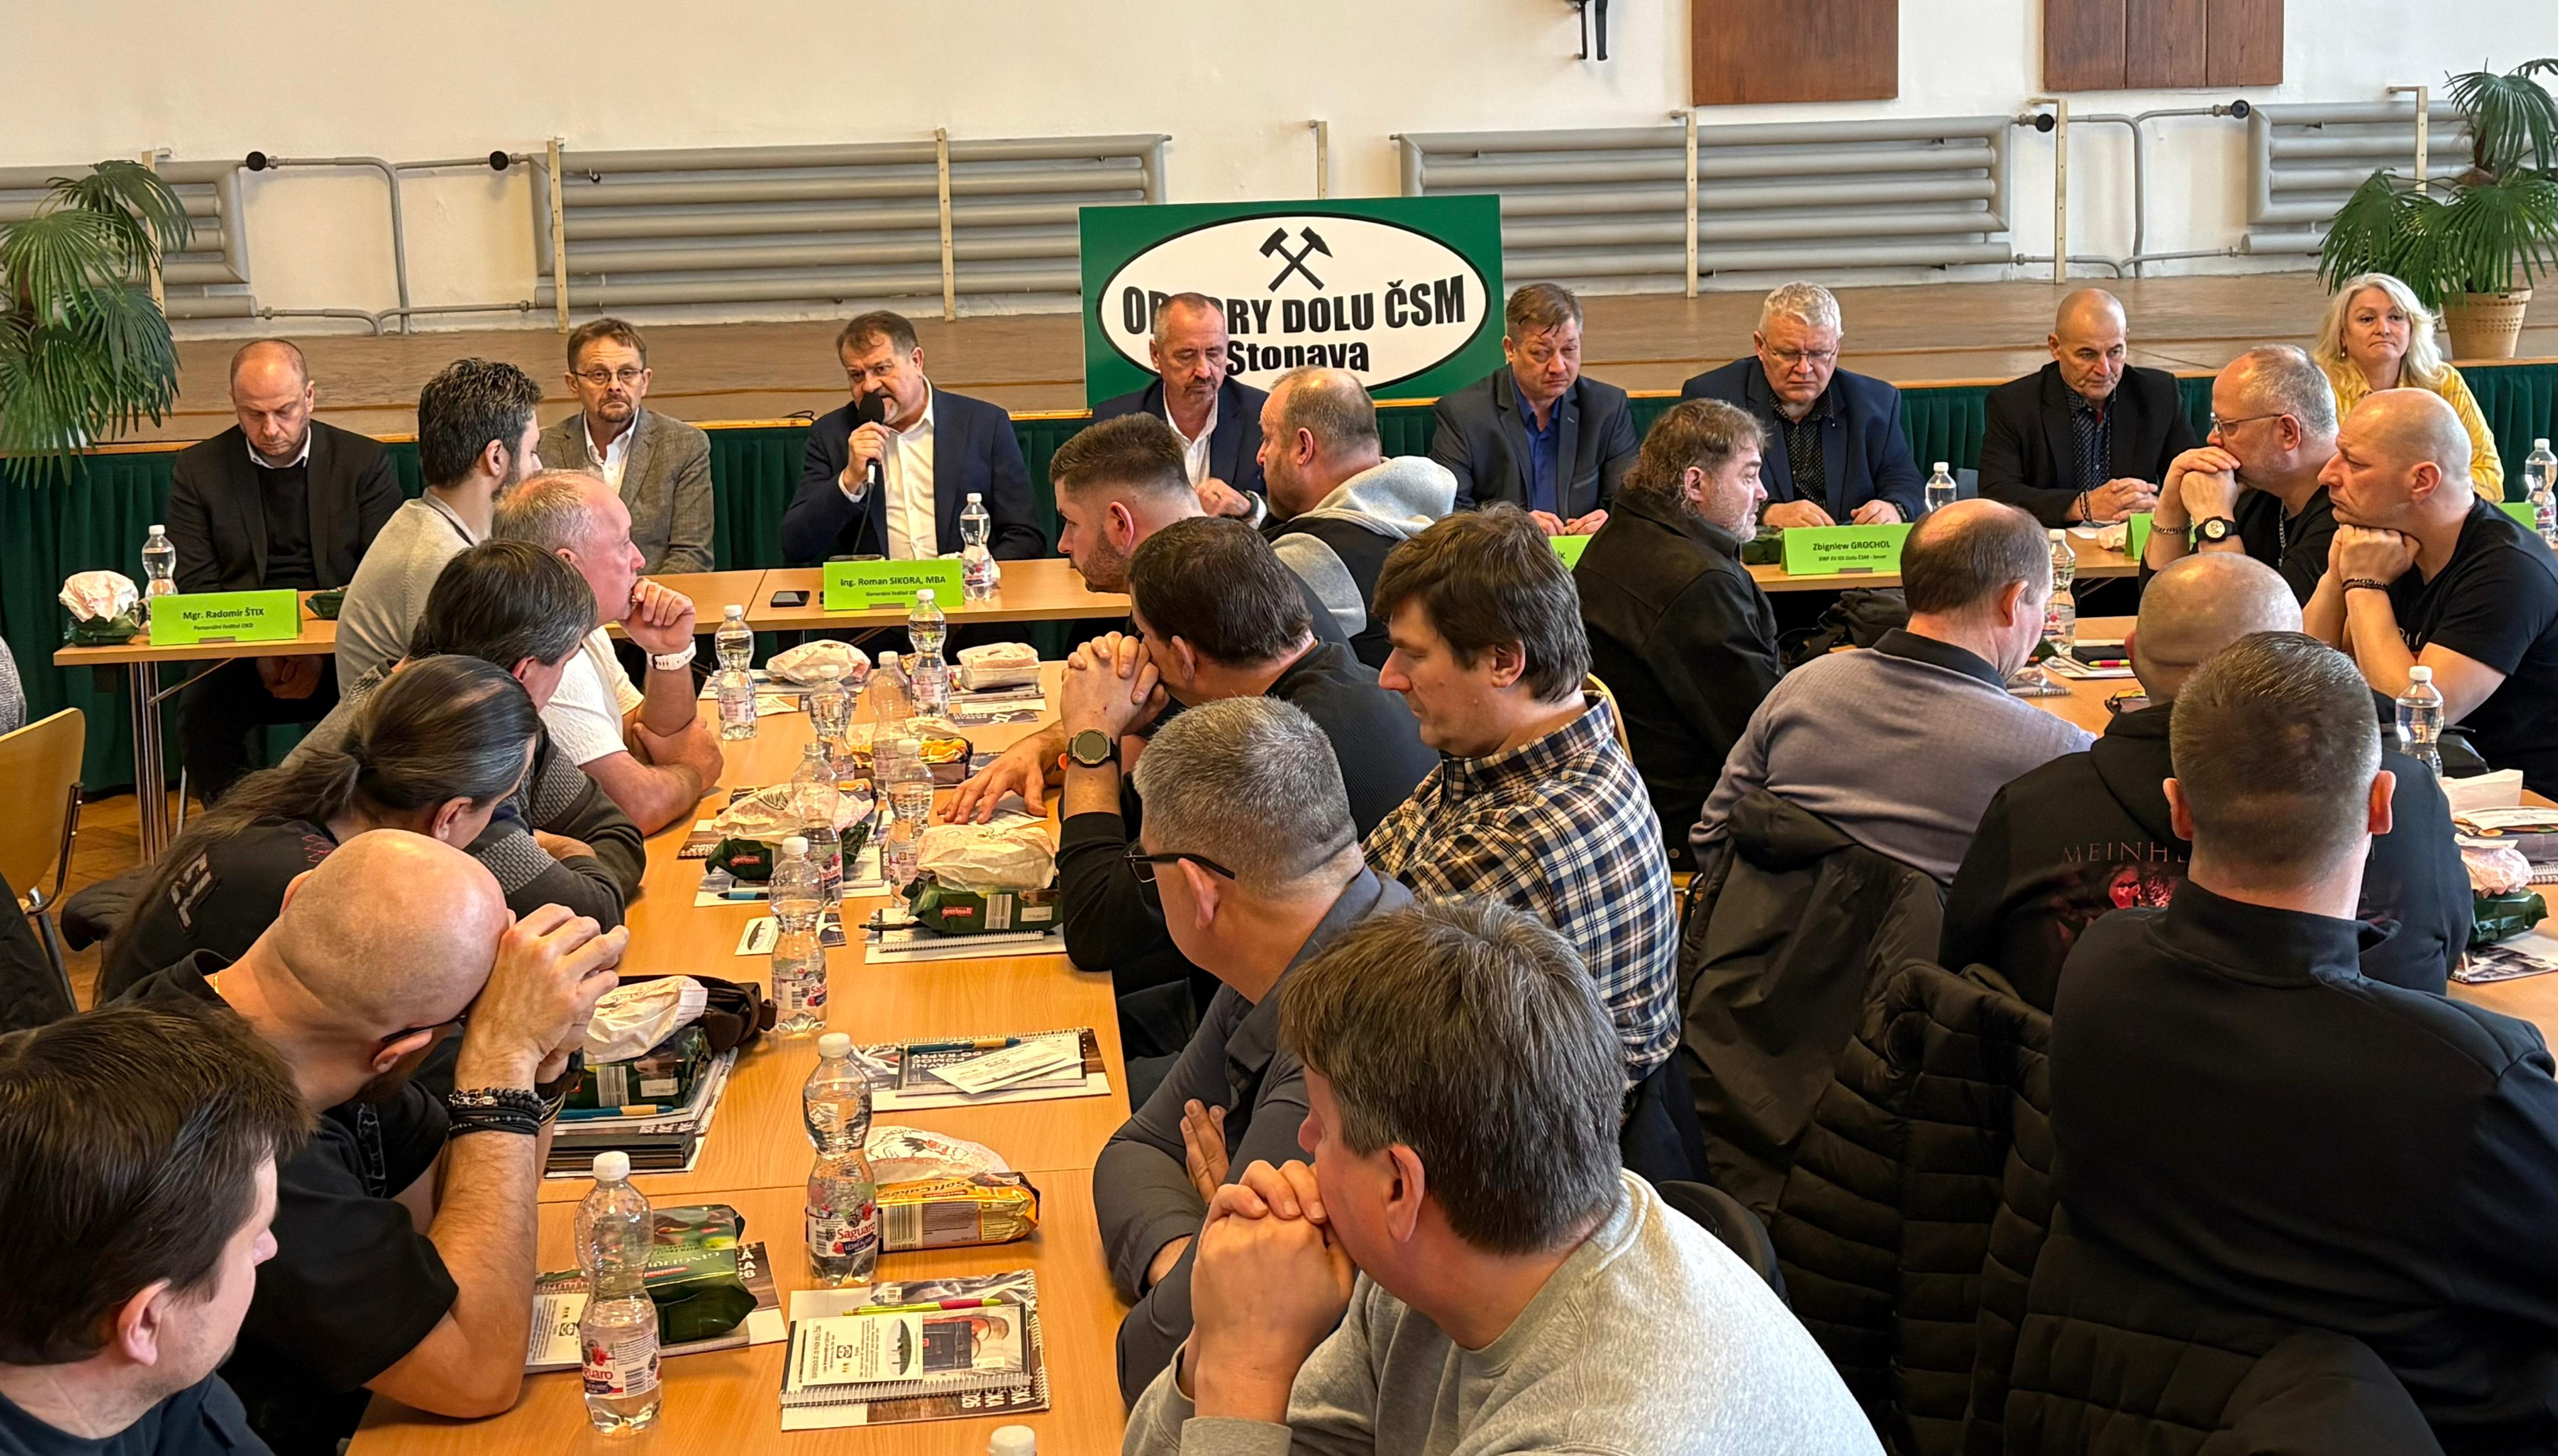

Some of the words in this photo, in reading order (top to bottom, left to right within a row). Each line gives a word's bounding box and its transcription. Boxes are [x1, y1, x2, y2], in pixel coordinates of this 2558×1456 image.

[1282, 292, 1374, 333] DOLU
[1385, 274, 1466, 328] ČSM
[1226, 340, 1370, 376] Stonava
[1813, 543, 1849, 552] Zbigniew
[1851, 540, 1891, 550] GROCHOL
[840, 578, 856, 587] Ing.
[890, 577, 923, 585] SIKORA,
[183, 611, 204, 620] Mgr.
[245, 606, 264, 616] ŠTIX
[837, 1221, 875, 1240] Saguaro
